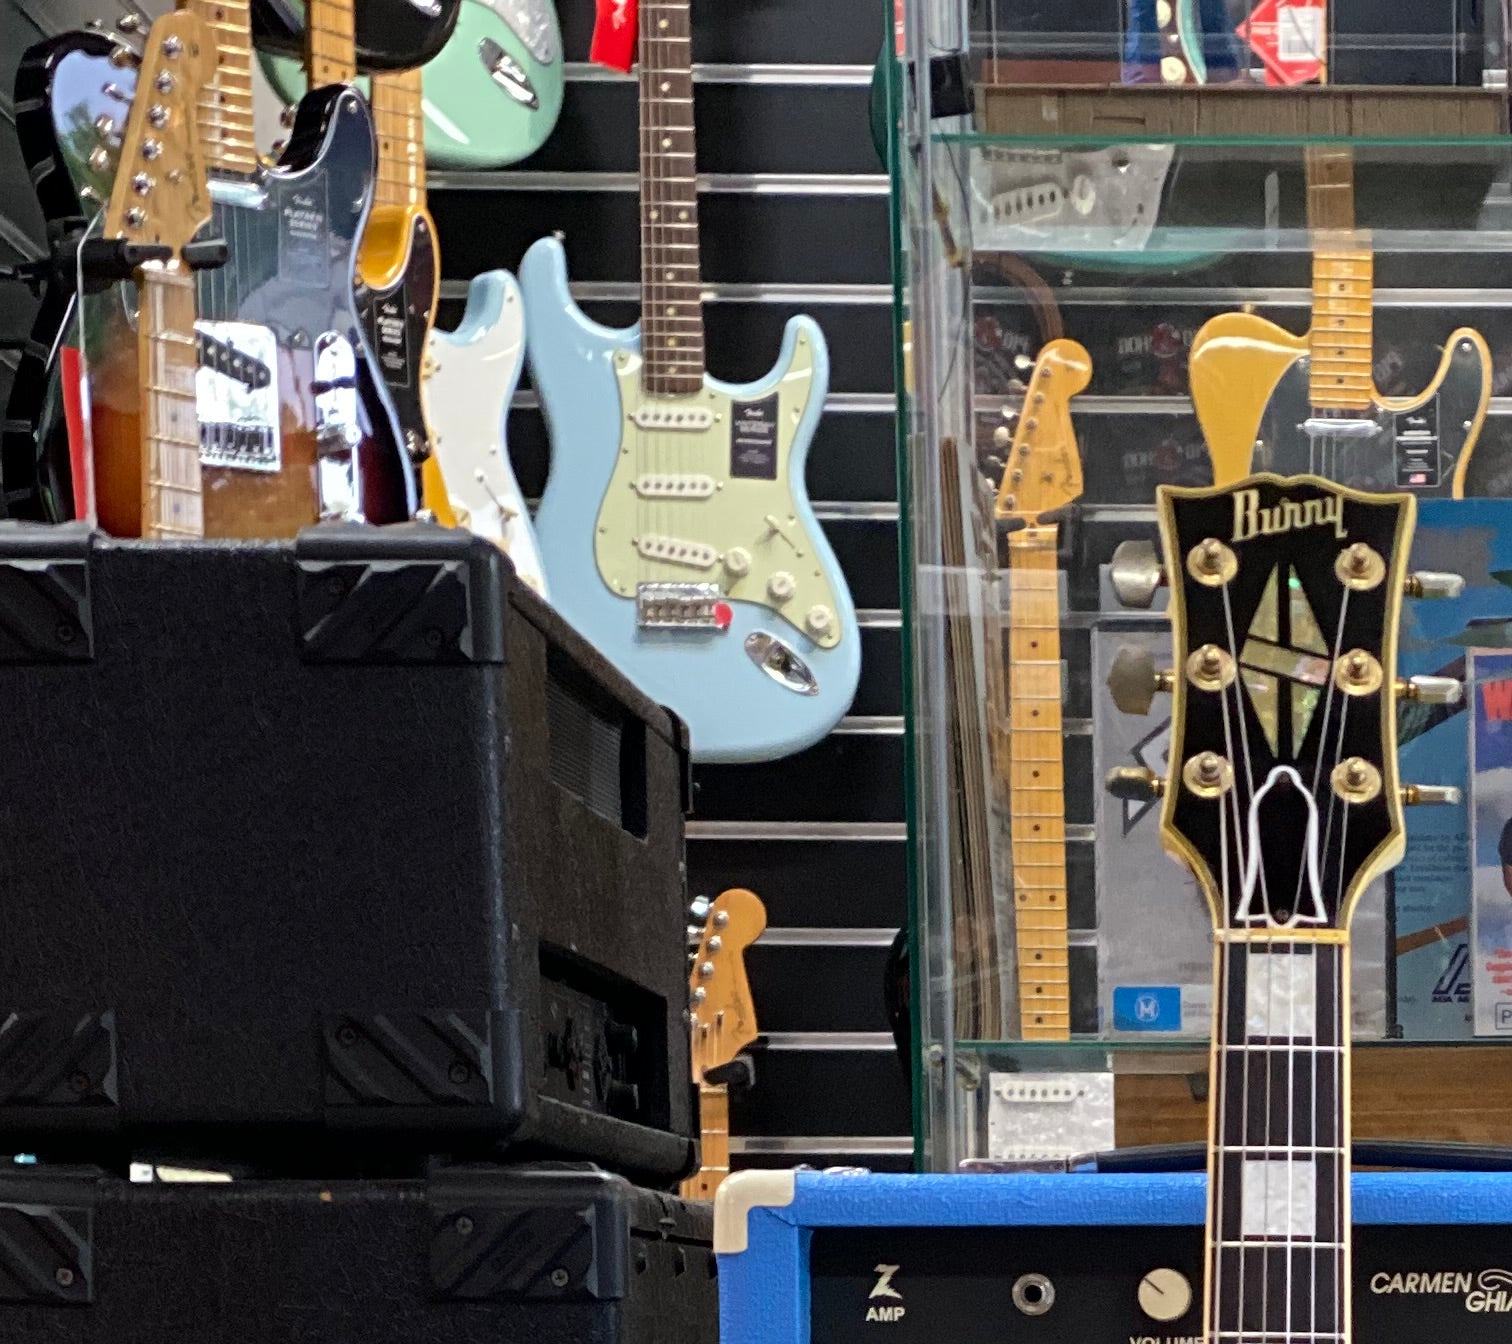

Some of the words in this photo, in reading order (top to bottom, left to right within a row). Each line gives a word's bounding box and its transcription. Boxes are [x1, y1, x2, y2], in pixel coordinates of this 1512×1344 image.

[1232, 488, 1348, 543] Burny
[1370, 1272, 1472, 1294] CARMEN
[865, 1307, 905, 1322] AMP
